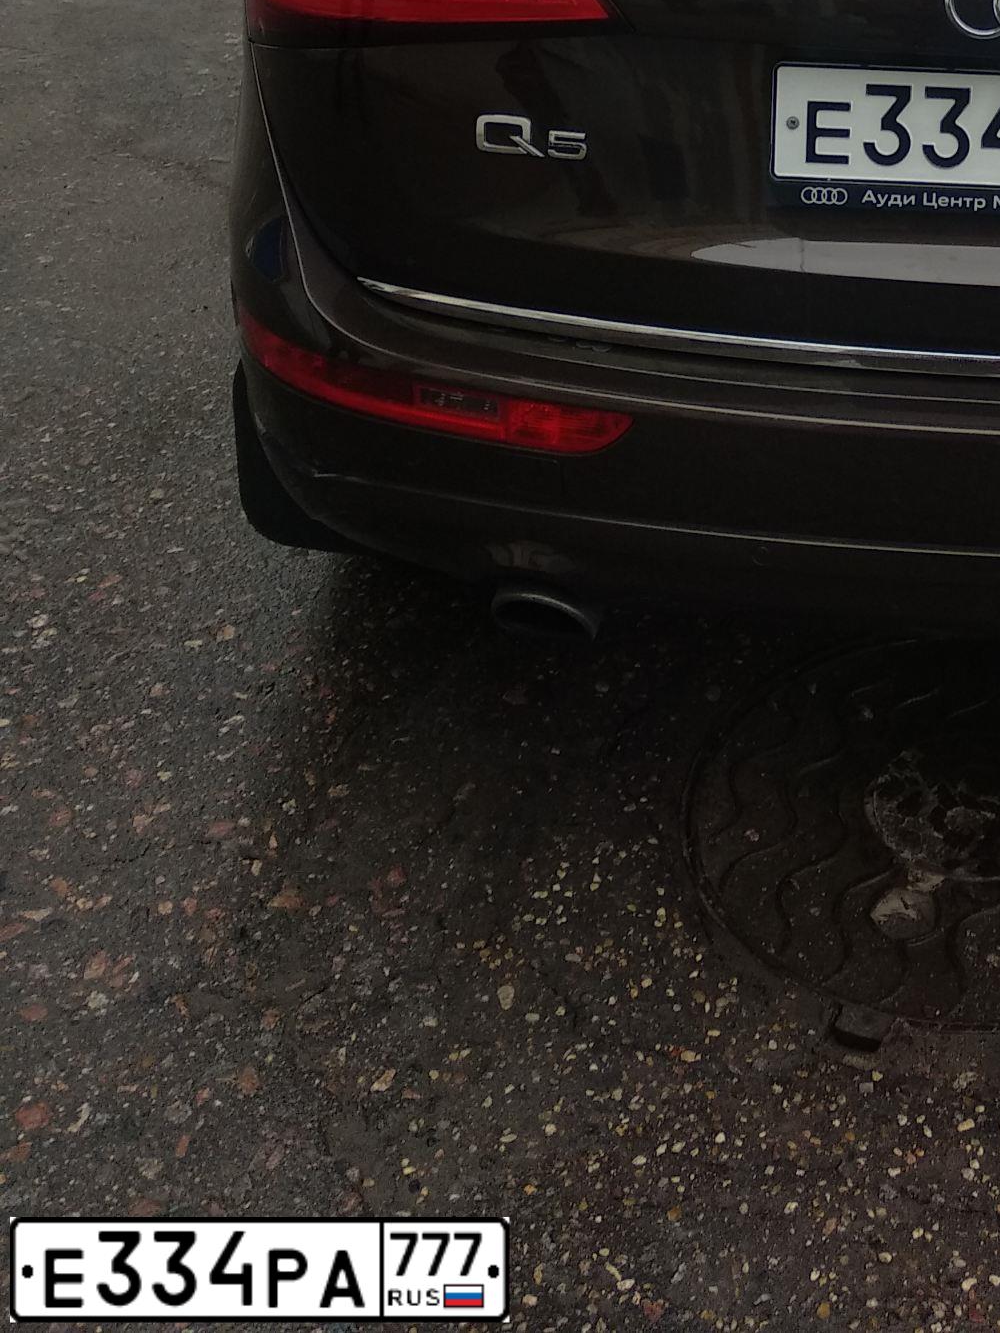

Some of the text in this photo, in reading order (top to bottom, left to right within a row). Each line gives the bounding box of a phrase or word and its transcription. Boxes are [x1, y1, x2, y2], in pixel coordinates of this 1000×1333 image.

[476, 114, 588, 161] Q5
[861, 189, 916, 208] Ауди
[923, 192, 987, 212] Центр
